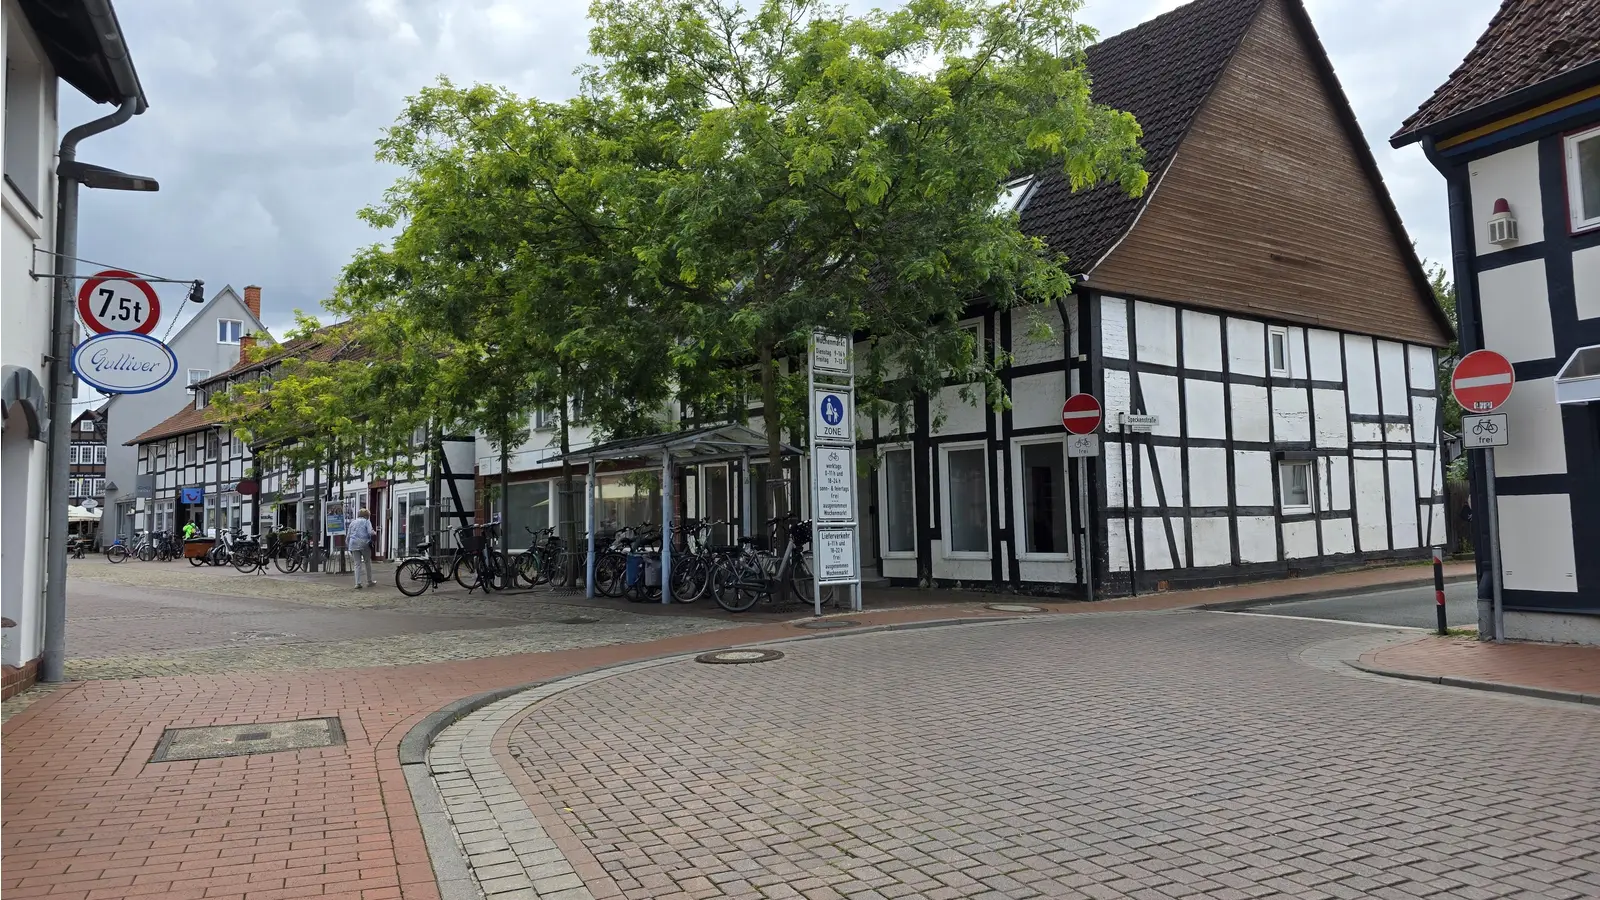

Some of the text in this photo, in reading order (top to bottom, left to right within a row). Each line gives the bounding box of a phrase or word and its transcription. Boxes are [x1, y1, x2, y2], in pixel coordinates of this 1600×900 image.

[98, 288, 142, 323] 7,5t
[816, 336, 846, 347] Wochenmarkt
[816, 348, 832, 357] Dienstag
[91, 348, 161, 372] Gulliver
[816, 356, 829, 364] Freitag
[1127, 415, 1157, 424] Speckenstraße
[824, 427, 841, 435] ZONE
[1478, 435, 1493, 443] frei
